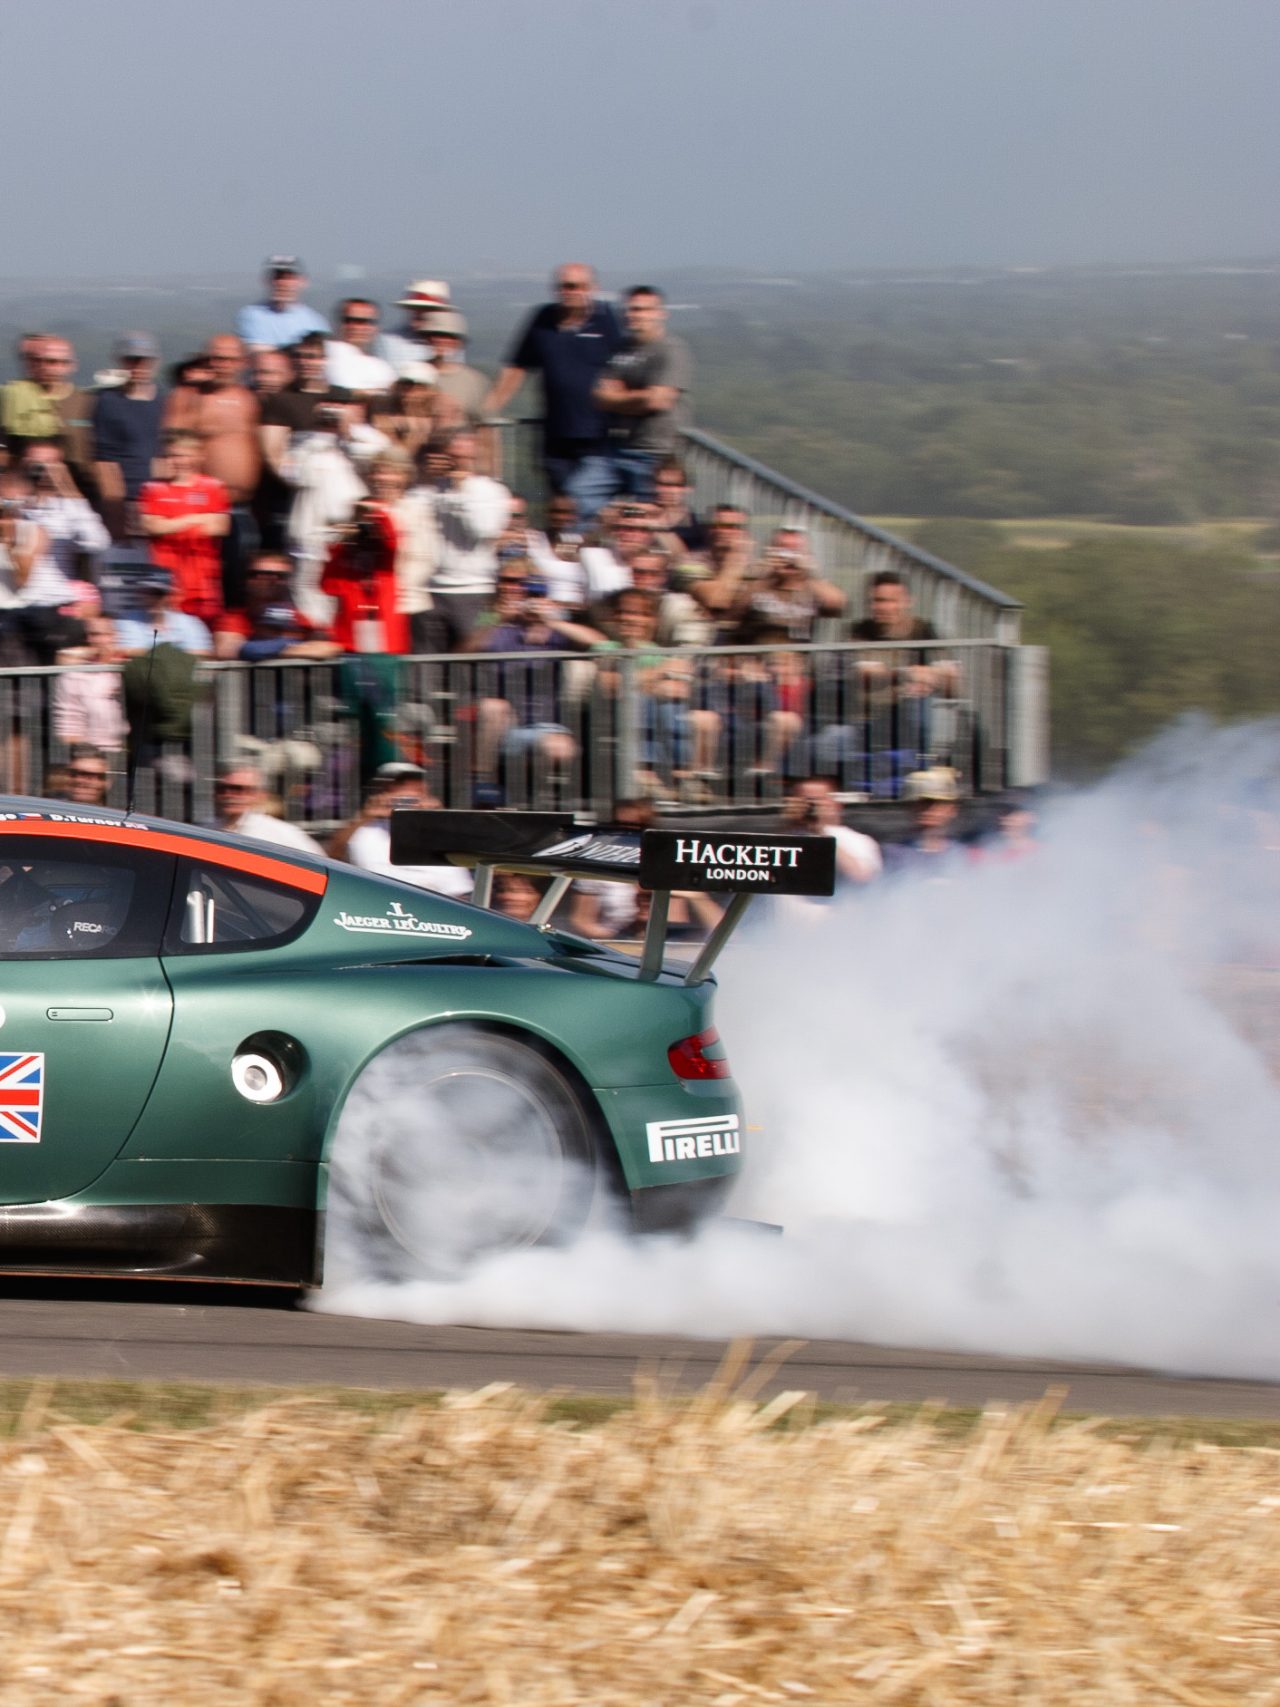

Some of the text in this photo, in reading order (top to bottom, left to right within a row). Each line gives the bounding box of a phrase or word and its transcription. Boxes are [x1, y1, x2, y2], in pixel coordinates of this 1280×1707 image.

[675, 839, 803, 867] HACKETT
[706, 868, 770, 881] LONDON
[334, 912, 391, 929] JAEGER
[646, 1114, 740, 1163] PIRELLI
